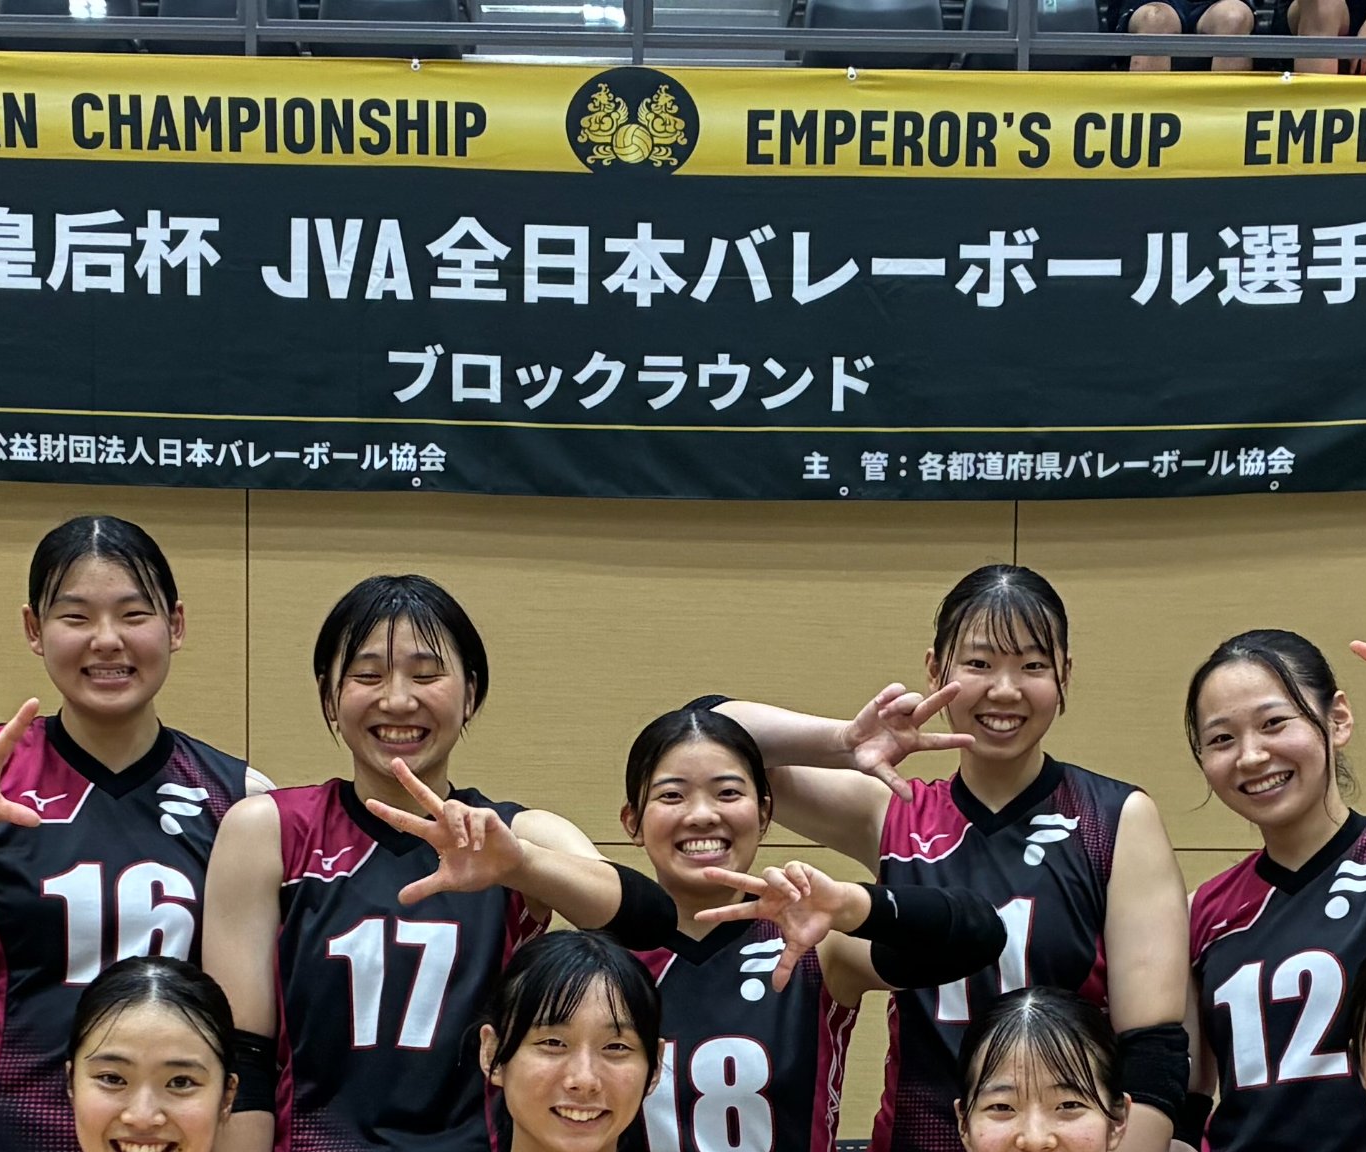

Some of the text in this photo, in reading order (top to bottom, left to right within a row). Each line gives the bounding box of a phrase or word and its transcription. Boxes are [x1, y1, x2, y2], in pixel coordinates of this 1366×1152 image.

[71, 92, 488, 158] CHAMPIONSHIP
[746, 109, 1051, 170] EMPEROR'S
[1073, 111, 1182, 170] CUP
[388, 346, 875, 413] ブロックラウンド
[40, 861, 197, 987] 16
[327, 916, 458, 1050] 17
[1213, 947, 1352, 1090] 12
